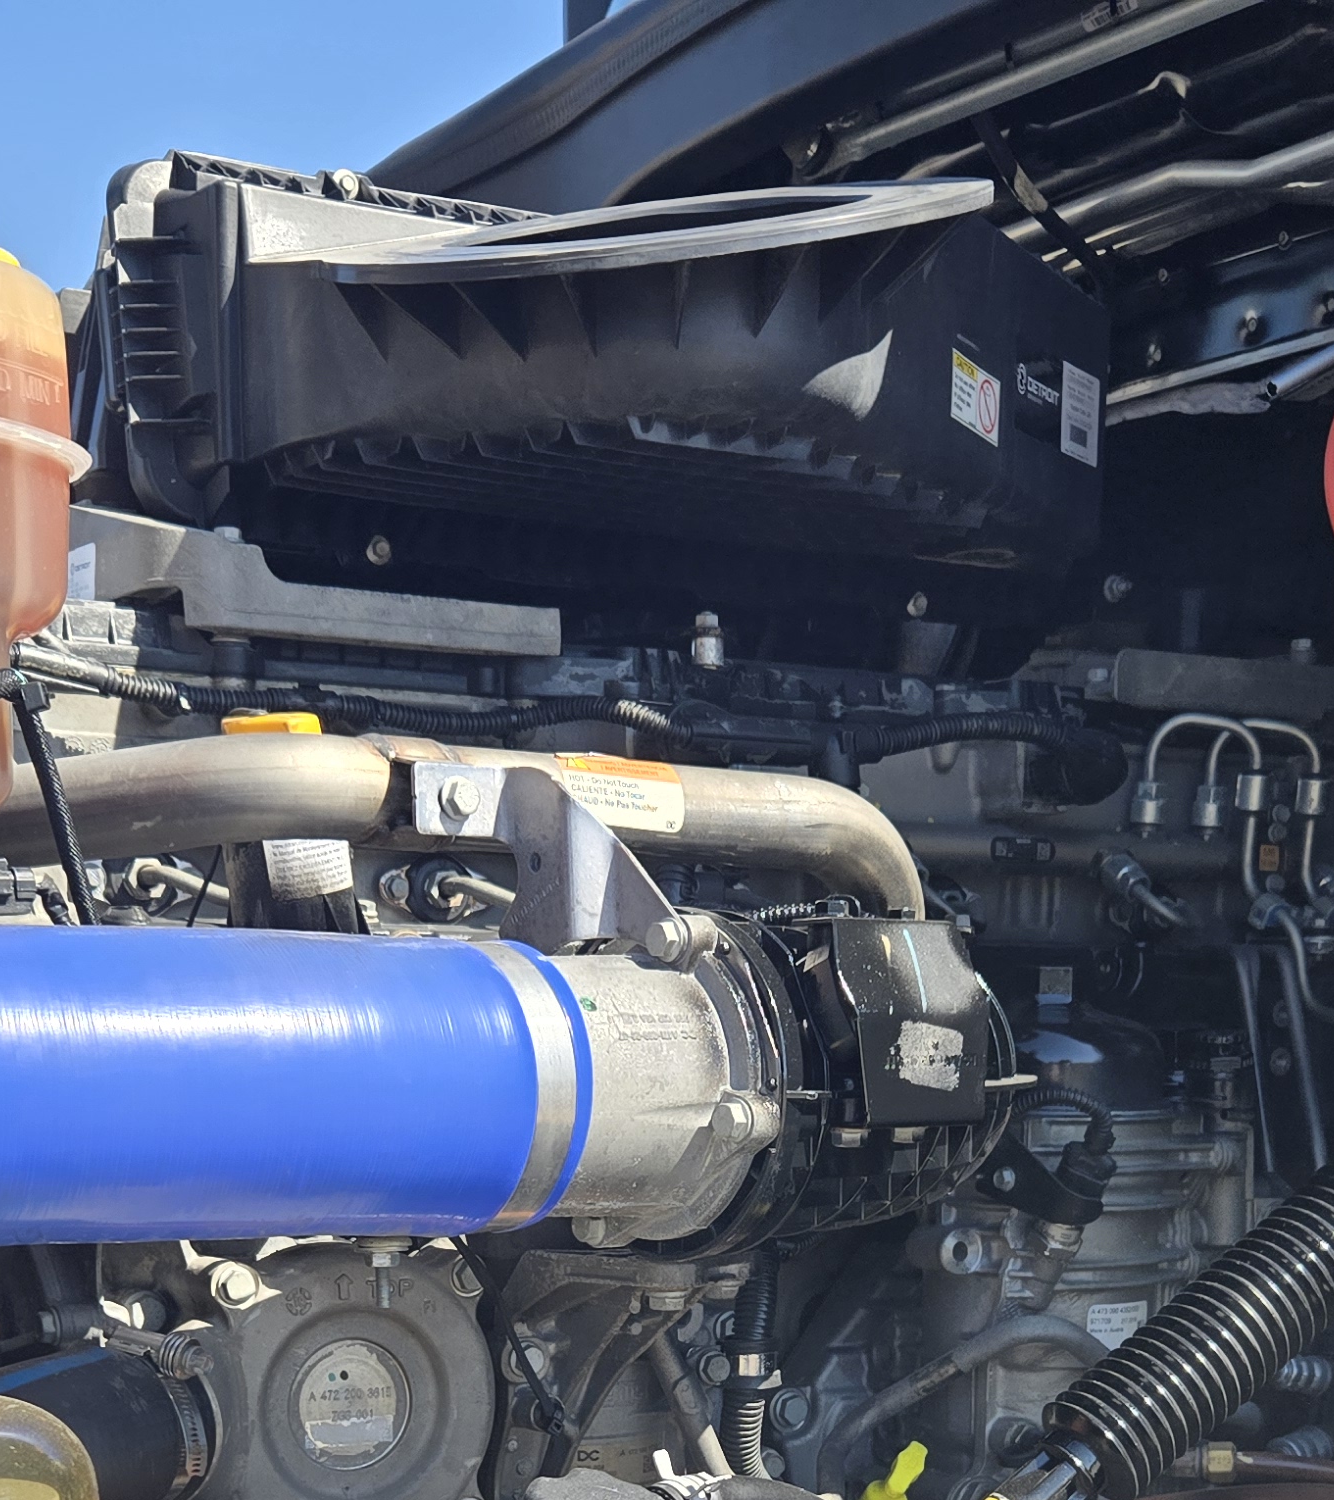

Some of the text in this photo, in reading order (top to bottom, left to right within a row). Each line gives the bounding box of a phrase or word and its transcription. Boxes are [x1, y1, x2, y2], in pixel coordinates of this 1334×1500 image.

[1027, 376, 1060, 406] DETROIT
[571, 784, 609, 796] CALIENTE
[615, 789, 625, 798] No
[573, 794, 599, 806] HAUD
[320, 1389, 340, 1401] 472
[577, 1449, 600, 1462] DC
